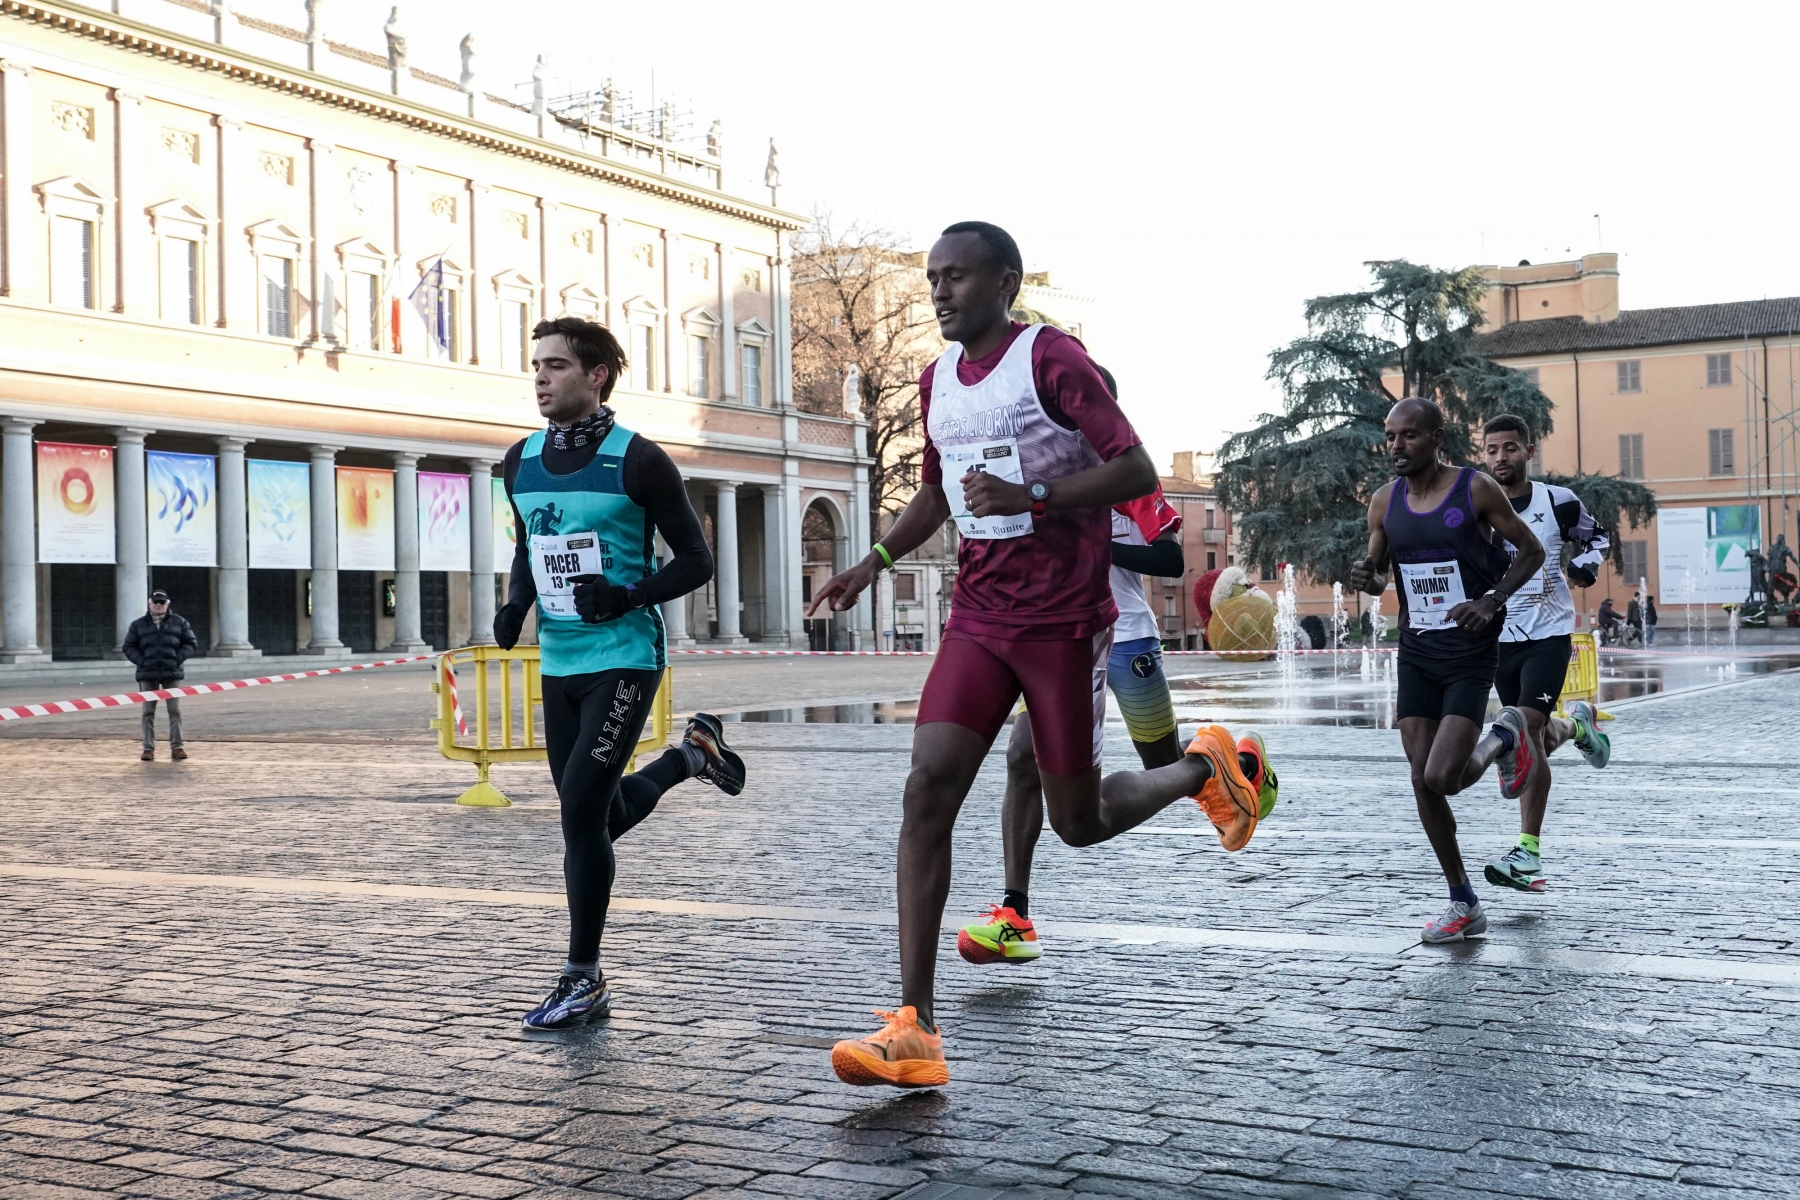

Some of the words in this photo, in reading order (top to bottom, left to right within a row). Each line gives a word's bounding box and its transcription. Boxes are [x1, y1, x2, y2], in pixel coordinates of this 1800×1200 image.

[969, 403, 1025, 437] LIVORNO
[992, 523, 1025, 536] Riunite
[543, 552, 581, 574] PACER
[551, 575, 564, 589] 13
[1410, 576, 1450, 595] SHUMAY
[1422, 595, 1429, 607] 1
[591, 680, 635, 762] NIKE
